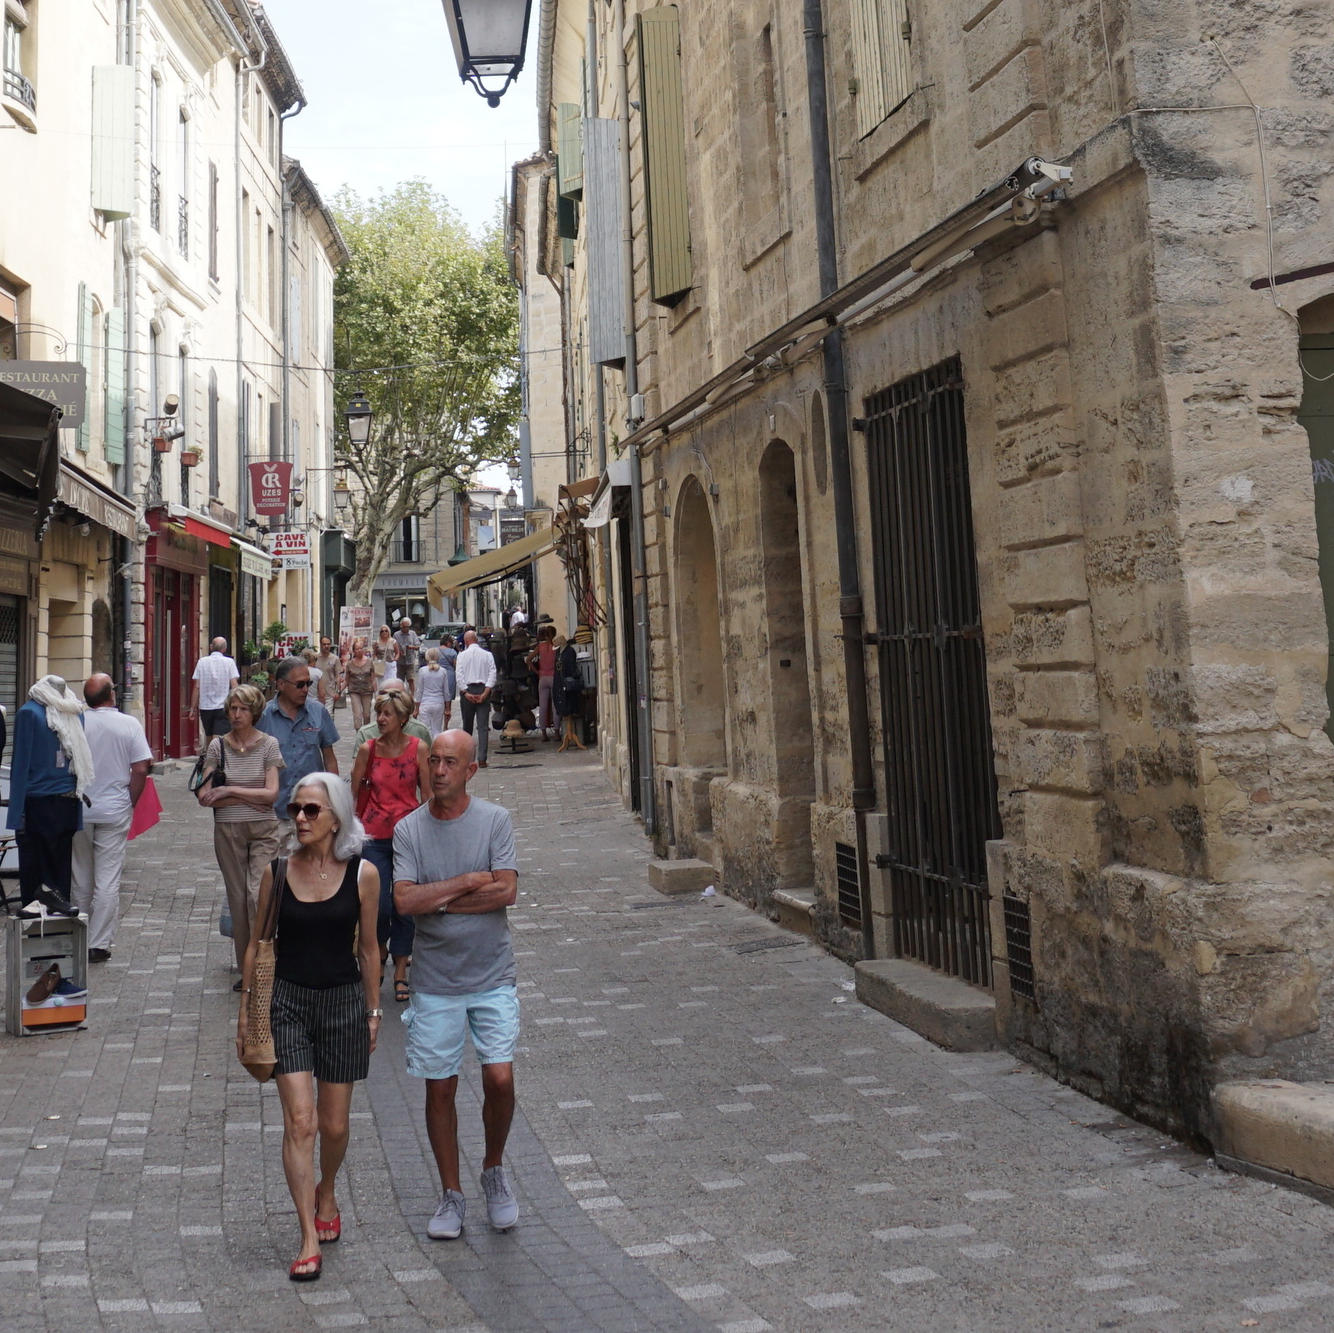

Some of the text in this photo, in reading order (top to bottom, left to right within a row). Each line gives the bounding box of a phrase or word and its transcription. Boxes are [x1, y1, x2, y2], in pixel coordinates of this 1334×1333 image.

[19, 388, 58, 401] ZZA
[261, 488, 282, 497] UZES
[275, 533, 307, 541] CAVE
[285, 540, 306, 548] VIN
